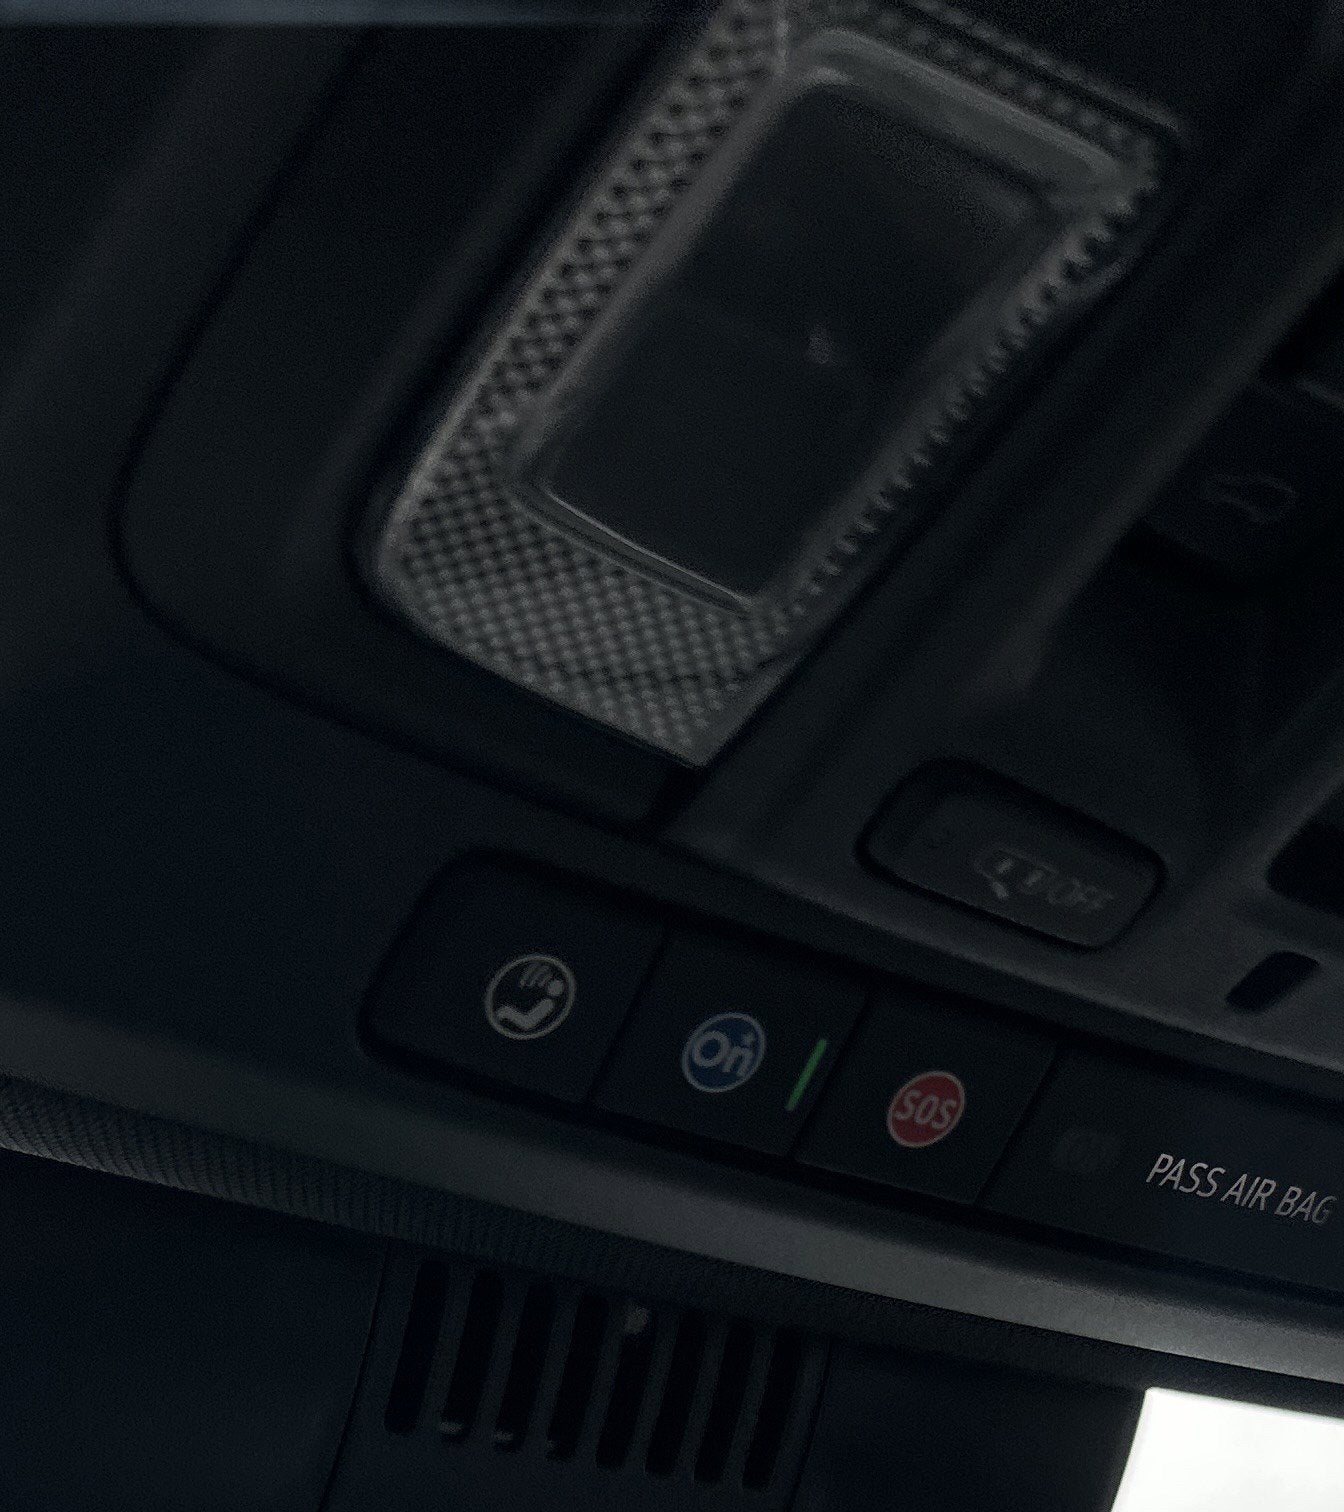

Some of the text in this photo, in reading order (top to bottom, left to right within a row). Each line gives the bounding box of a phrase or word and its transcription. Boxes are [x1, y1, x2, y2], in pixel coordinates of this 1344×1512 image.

[894, 1089, 958, 1131] SOS
[1145, 1153, 1226, 1198] PASS
[1220, 1173, 1277, 1211] AIR
[1274, 1186, 1337, 1226] BAG
